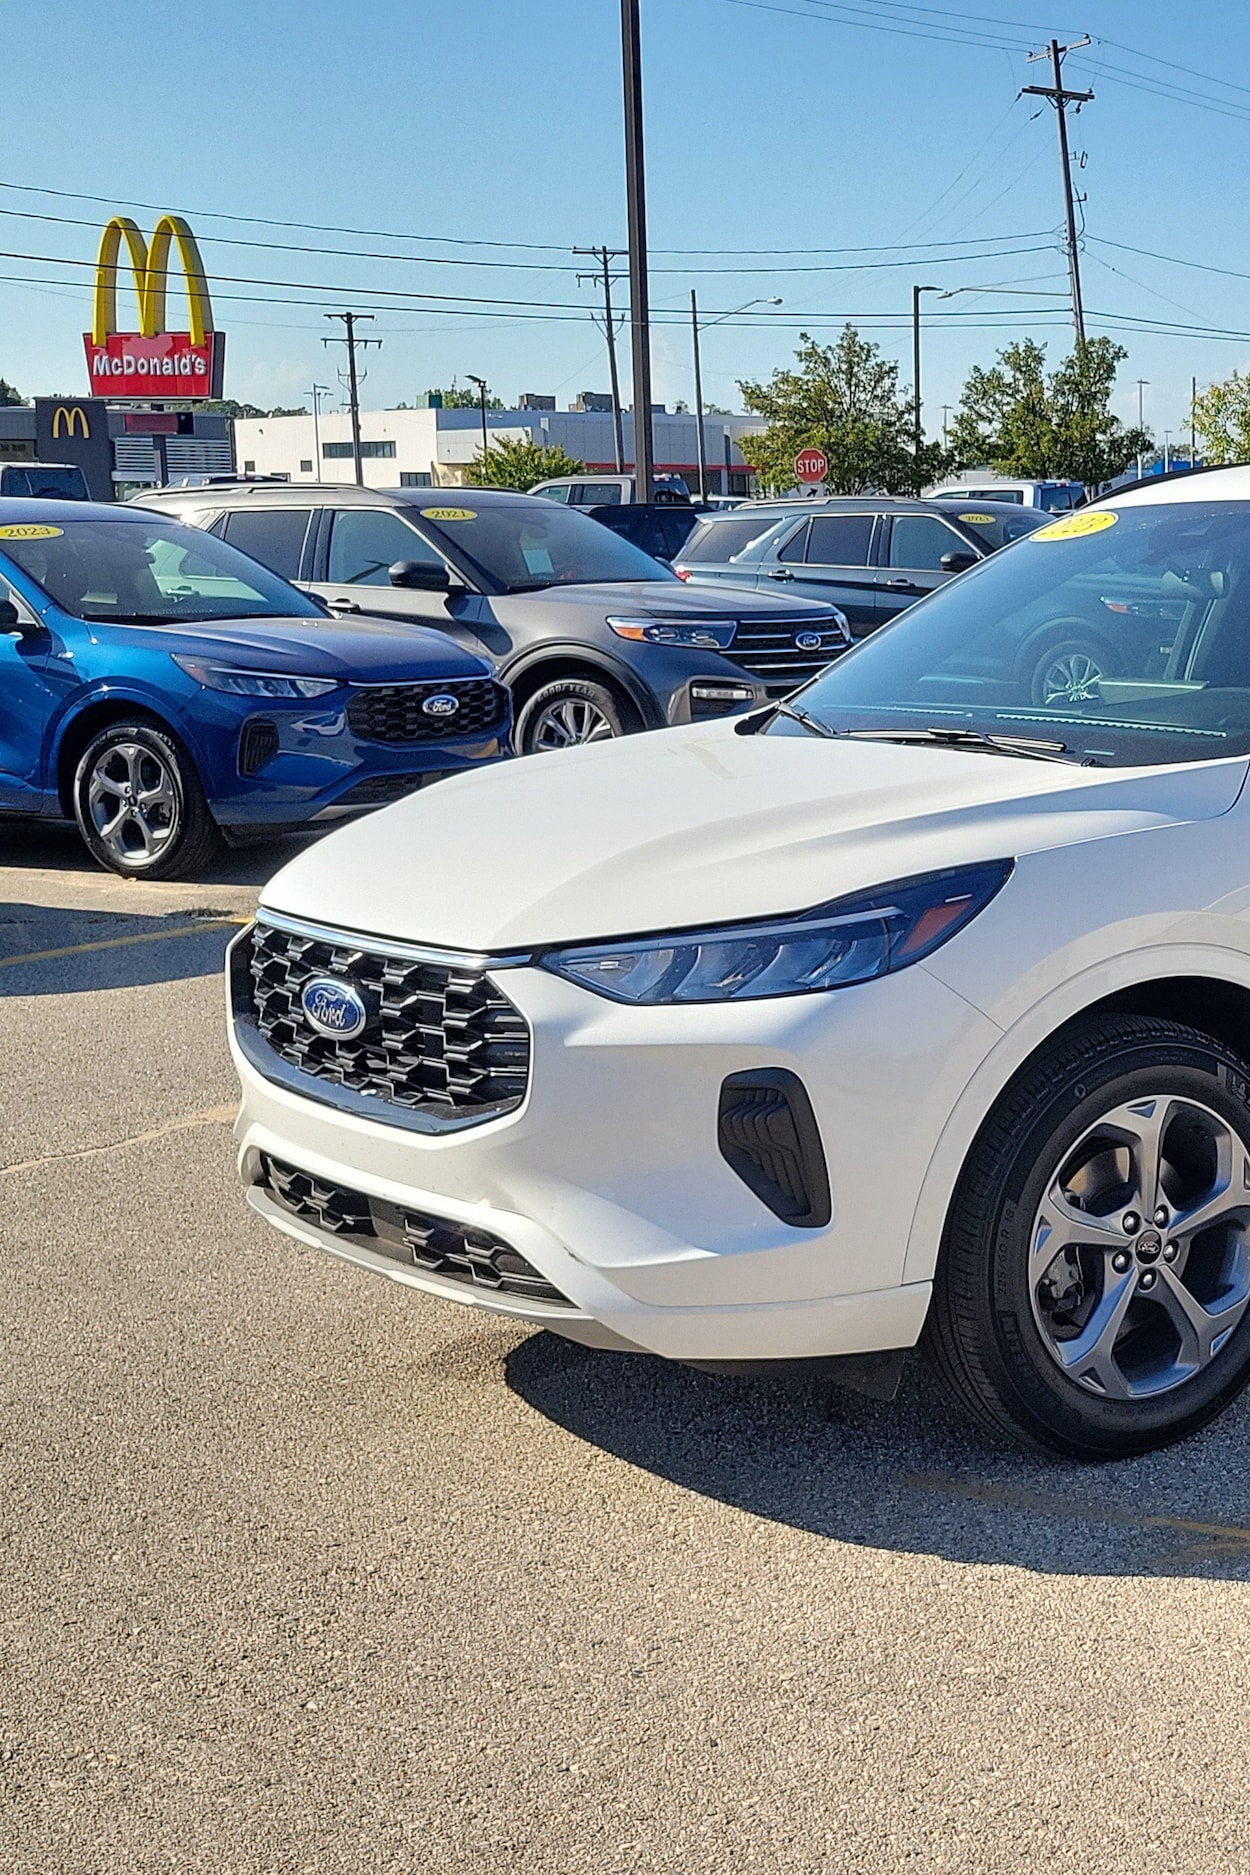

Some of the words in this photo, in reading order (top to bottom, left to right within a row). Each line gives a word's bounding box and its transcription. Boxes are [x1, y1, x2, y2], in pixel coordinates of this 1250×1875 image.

[92, 353, 207, 376] McDonald's
[797, 459, 825, 473] STOP
[432, 510, 467, 519] 2021
[4, 527, 51, 538] 2023
[537, 683, 596, 702] GOODYEAR
[311, 989, 347, 1028] Ford
